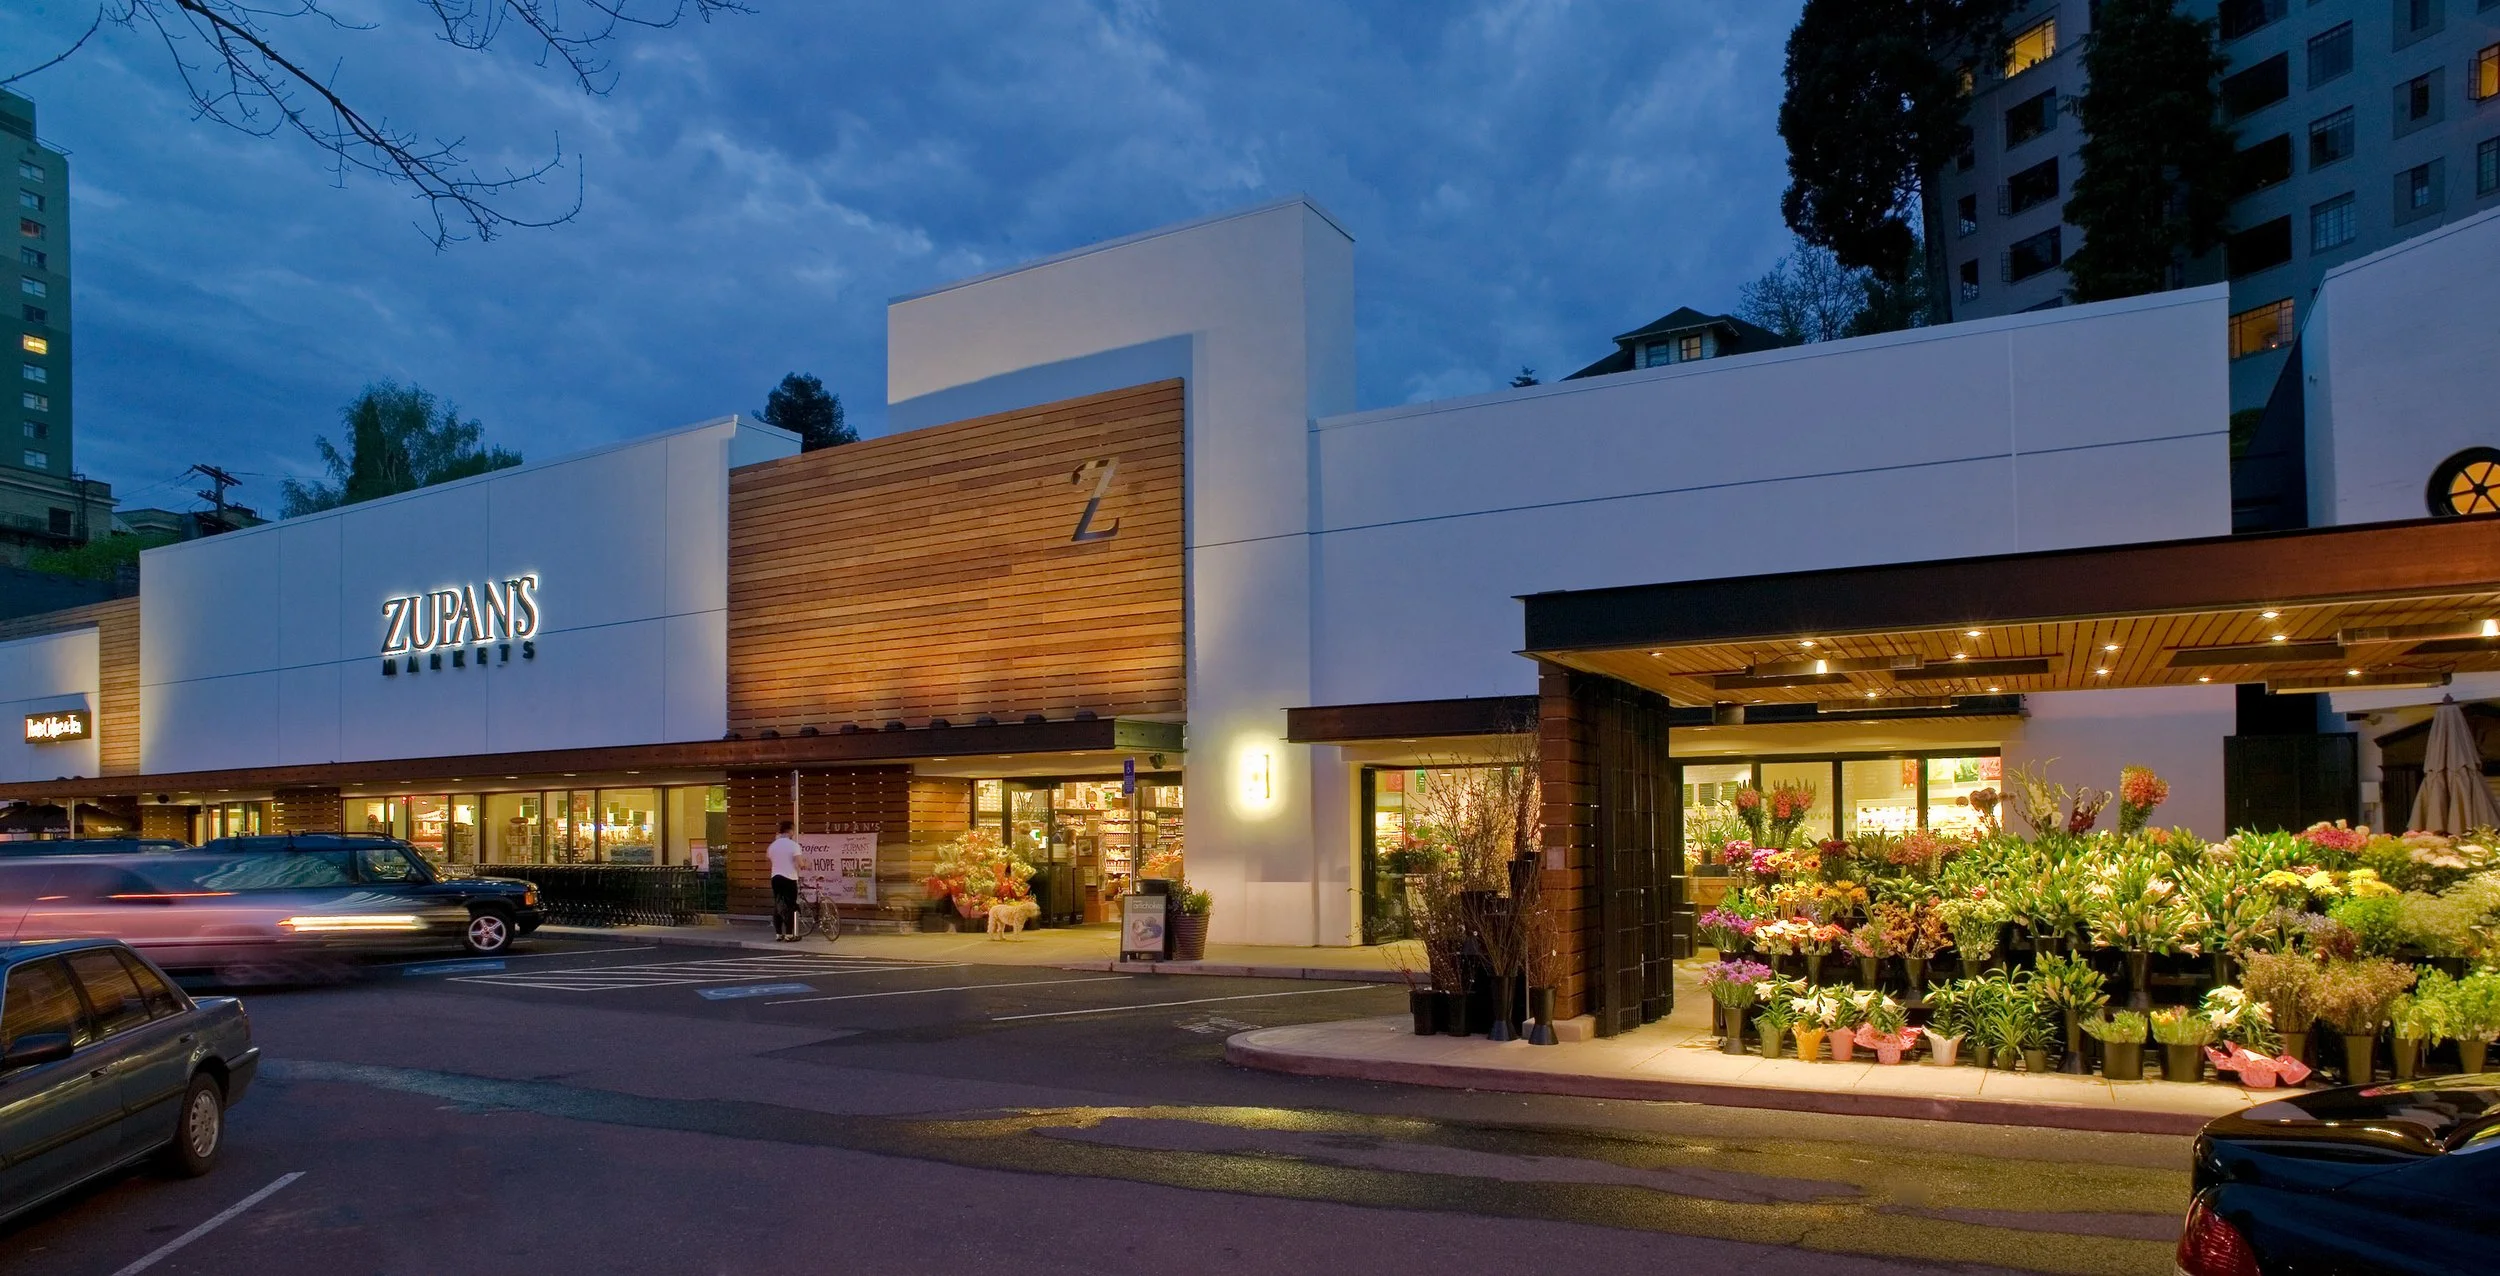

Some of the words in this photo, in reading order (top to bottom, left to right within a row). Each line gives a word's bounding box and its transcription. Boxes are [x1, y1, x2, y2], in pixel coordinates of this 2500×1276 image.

[1070, 457, 1120, 542] Z
[381, 575, 539, 655] ZUPAN'S
[382, 641, 535, 676] MARKETS
[825, 823, 880, 831] ZUPAN'S
[814, 858, 835, 872] HOPE
